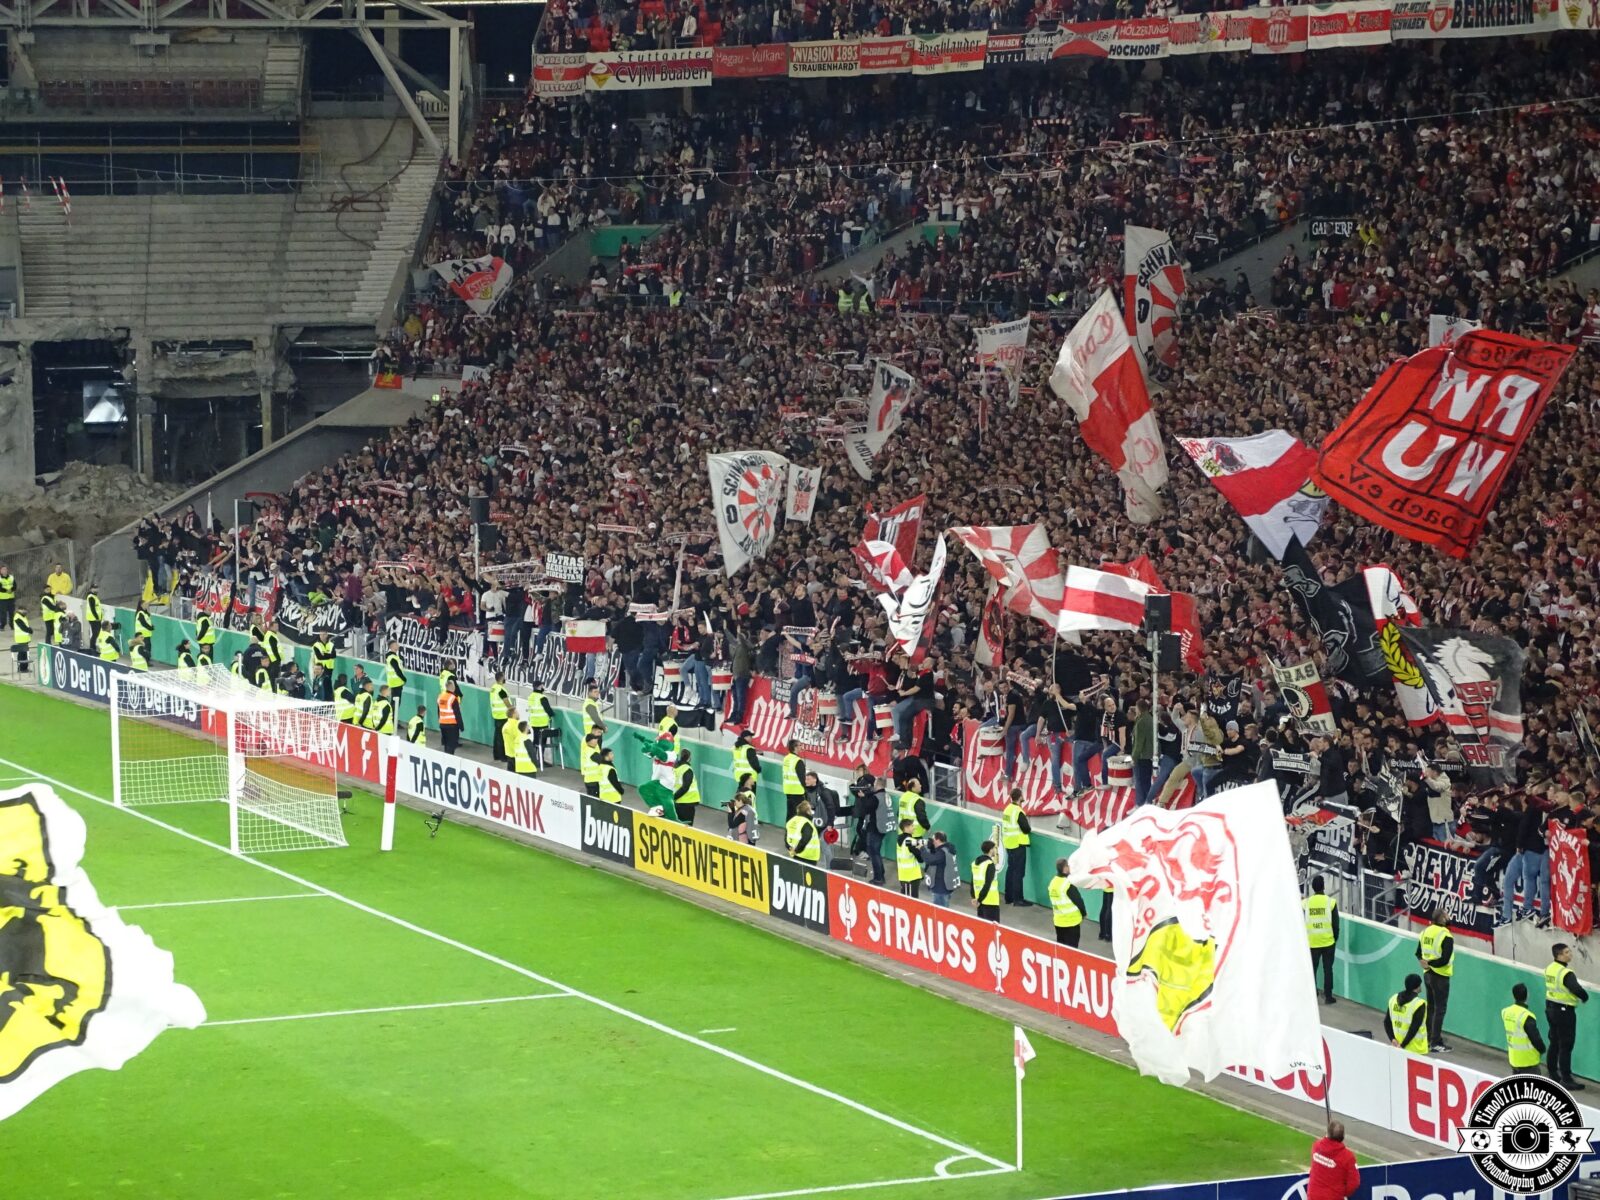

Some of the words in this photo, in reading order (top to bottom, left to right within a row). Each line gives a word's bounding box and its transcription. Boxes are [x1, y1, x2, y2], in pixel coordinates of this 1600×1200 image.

[1451, 0, 1534, 29] BERKHEIM
[617, 49, 709, 63] Stuttgarter
[792, 45, 834, 63] INVASION
[1109, 43, 1160, 57] HOCHDORF
[615, 67, 656, 86] CVJM
[660, 64, 708, 82] Buaben
[792, 61, 858, 72] STRAUBENHARDT
[546, 553, 585, 567] ULTRAS
[69, 658, 91, 693] Der
[409, 755, 472, 810] TARGO
[488, 778, 546, 834] BANK
[583, 804, 631, 859] bwin
[639, 822, 764, 902] SPORTWETTEN
[772, 864, 826, 925] bwin
[866, 899, 977, 974] STRAUSS
